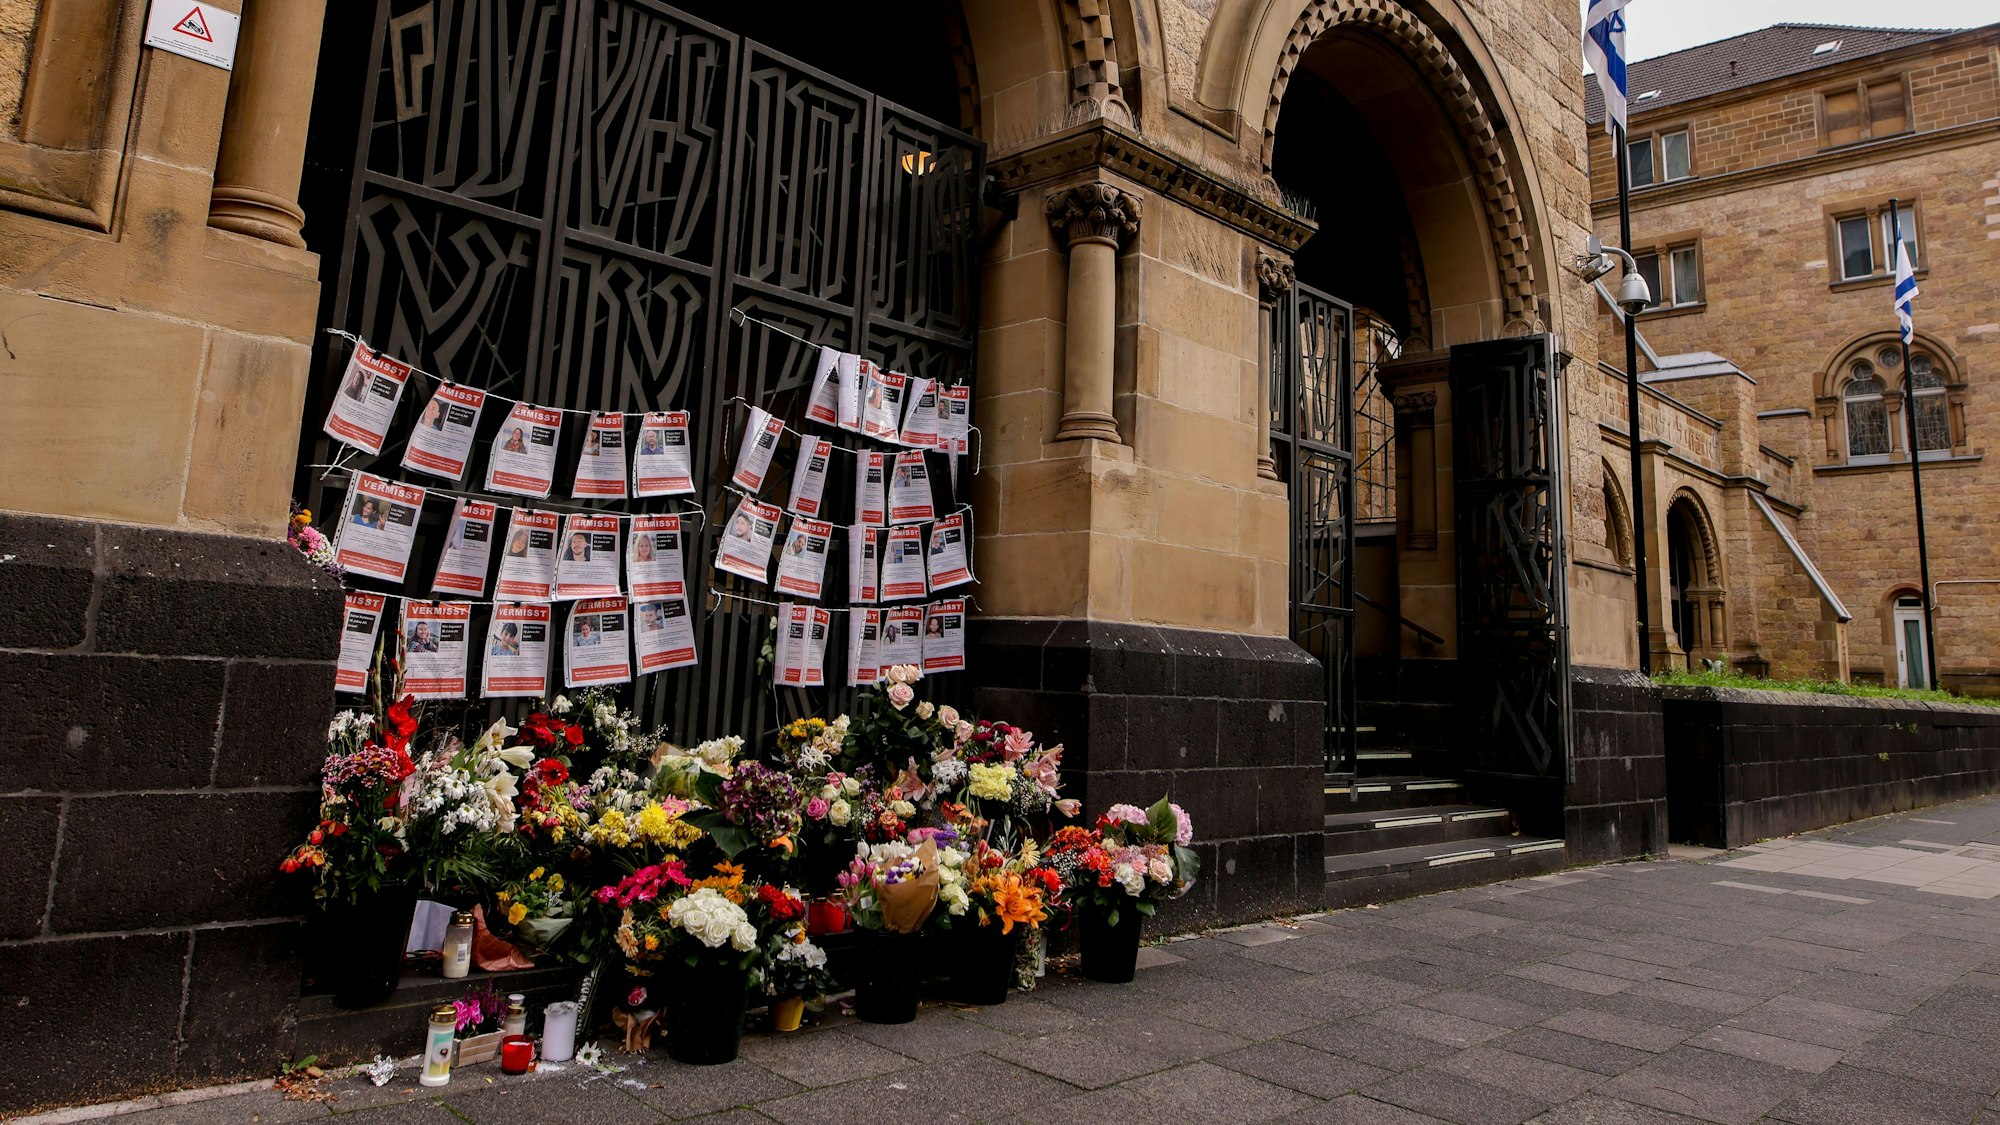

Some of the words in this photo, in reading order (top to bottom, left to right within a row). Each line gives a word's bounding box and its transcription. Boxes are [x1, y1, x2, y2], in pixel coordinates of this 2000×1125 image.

[359, 348, 406, 377] VERMISST
[440, 385, 480, 403] RMISST
[514, 407, 558, 422] ERMISST
[363, 479, 421, 500] VERMISST
[572, 519, 616, 528] VERMISST
[635, 519, 677, 528] VERMISST
[411, 605, 466, 616] VERMISST
[499, 604, 547, 617] VERMISST
[577, 599, 624, 610] VERMISST
